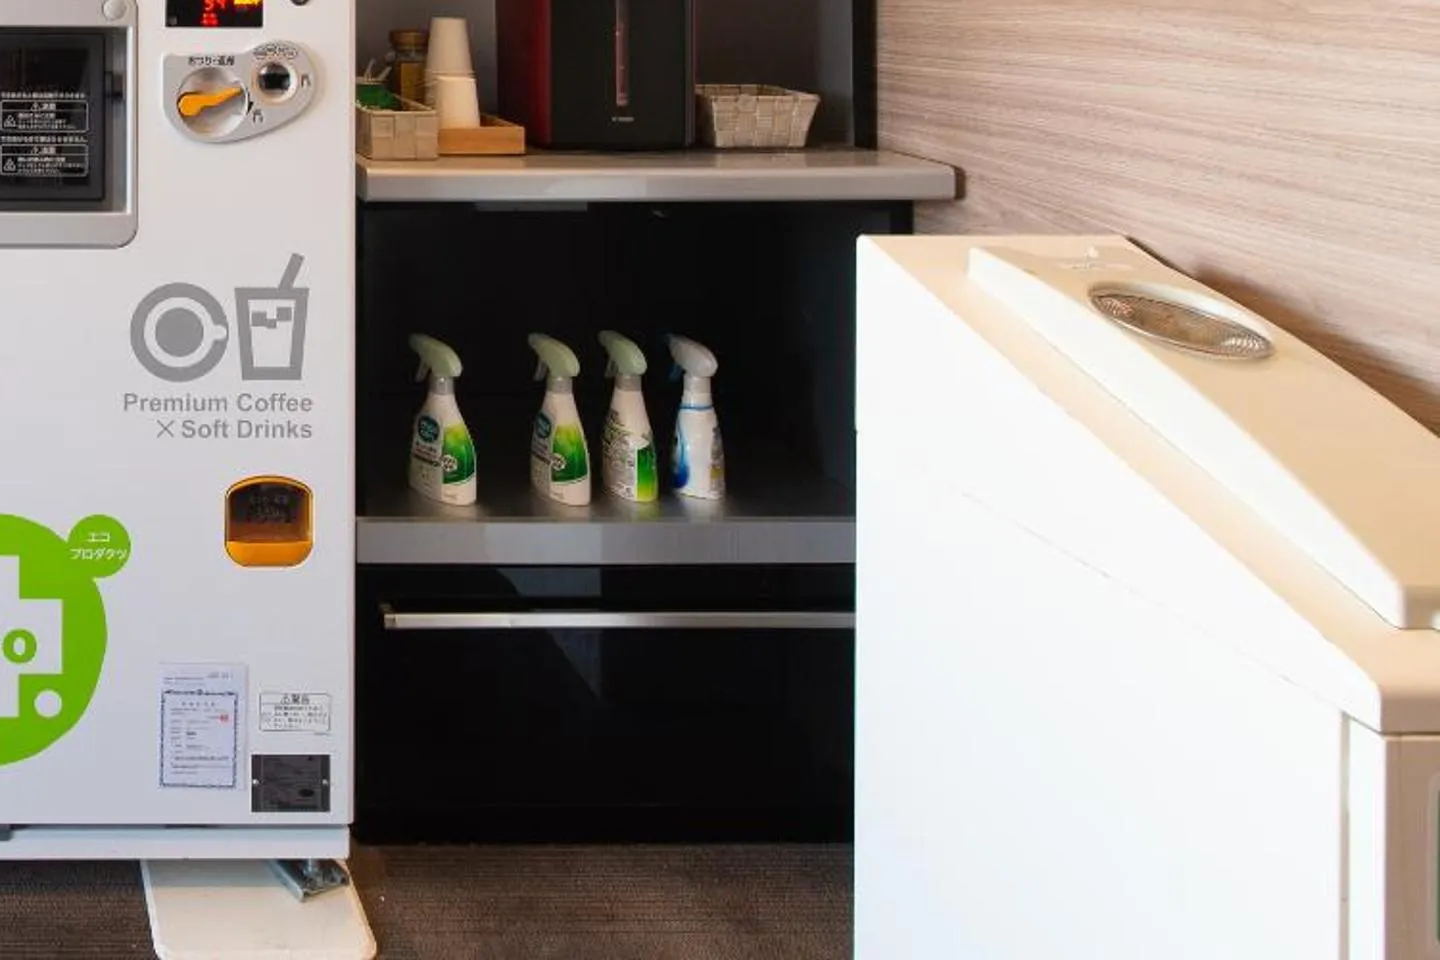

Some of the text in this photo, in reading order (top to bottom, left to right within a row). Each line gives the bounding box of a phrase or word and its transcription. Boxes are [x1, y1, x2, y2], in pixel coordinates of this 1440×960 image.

[123, 392, 315, 412] Premium Coffee
[181, 419, 229, 439] Soft
[237, 419, 313, 439] Drinks
[87, 532, 110, 543] エコ
[70, 548, 129, 560] プロダクツ
